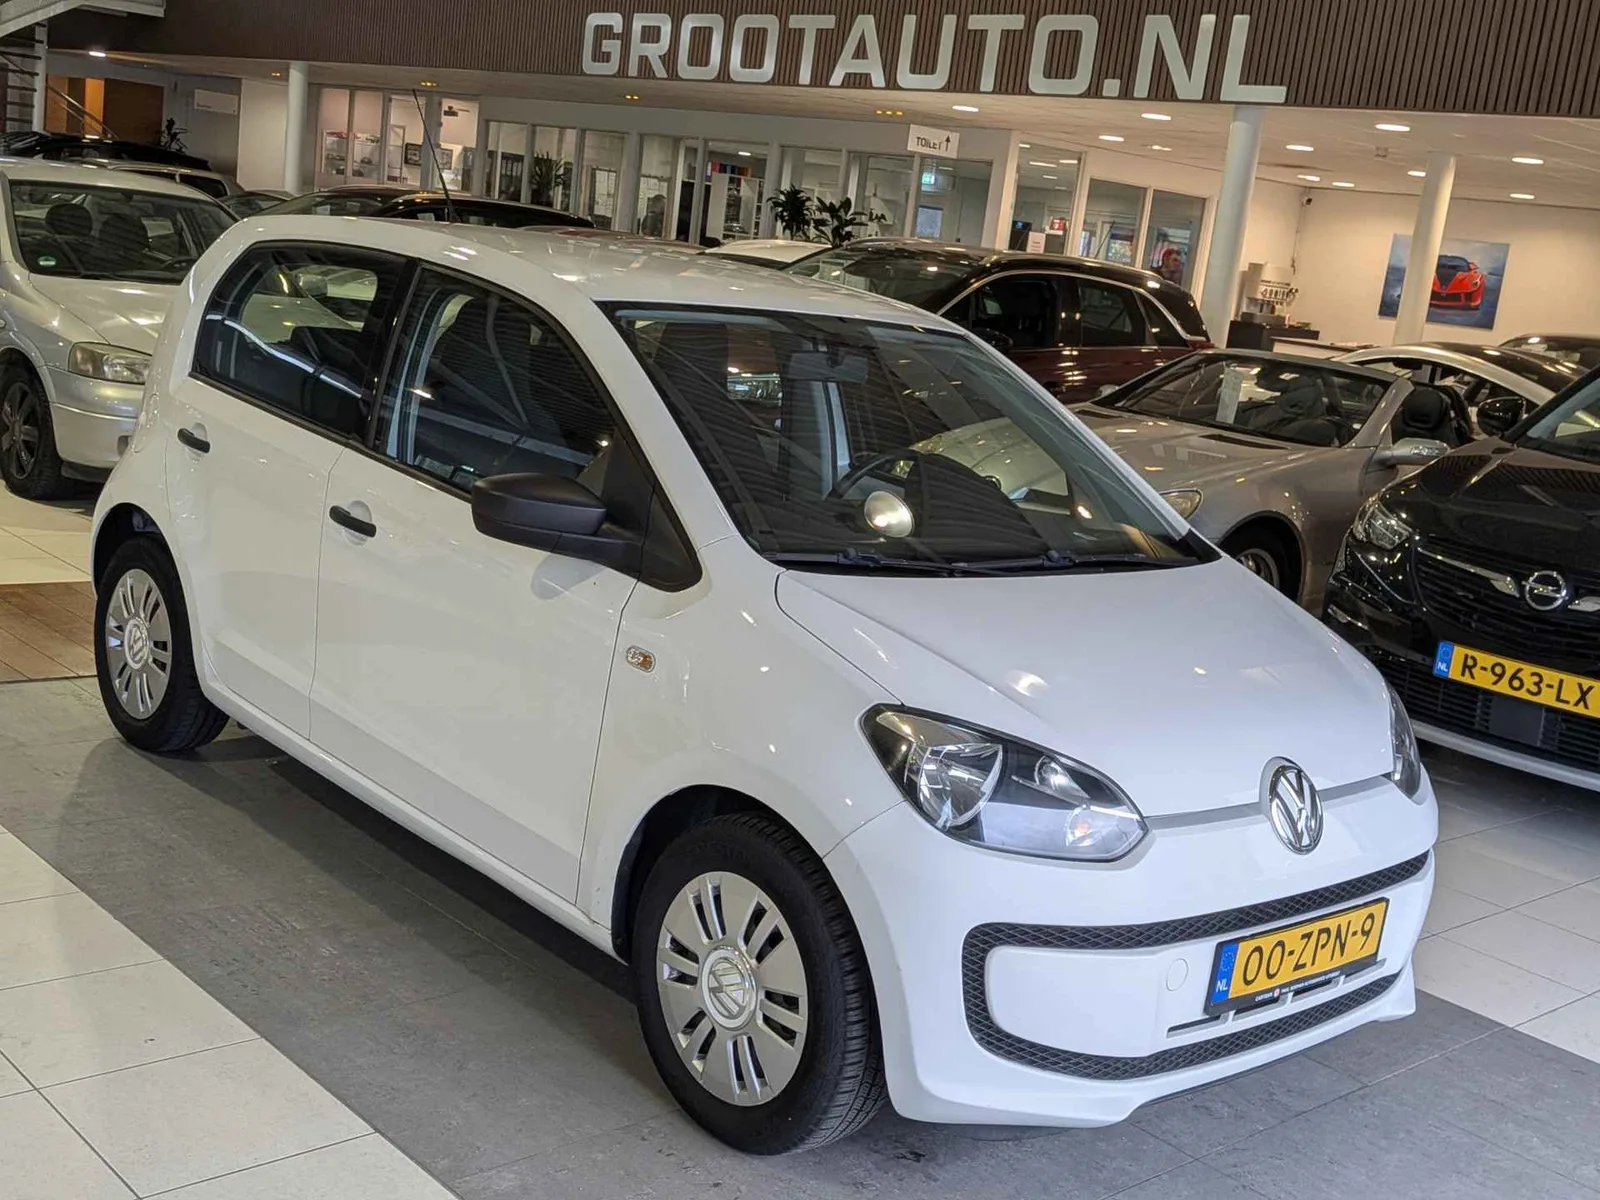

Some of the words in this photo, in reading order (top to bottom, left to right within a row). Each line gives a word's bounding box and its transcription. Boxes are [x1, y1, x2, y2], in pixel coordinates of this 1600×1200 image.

[582, 12, 1288, 104] GROOTAUTO.NL
[916, 136, 943, 151] TOILET
[1437, 661, 1449, 672] NL
[1460, 653, 1595, 710] R-963-LX
[1243, 912, 1375, 986] 00-ZPN-9
[1216, 977, 1229, 993] NL
